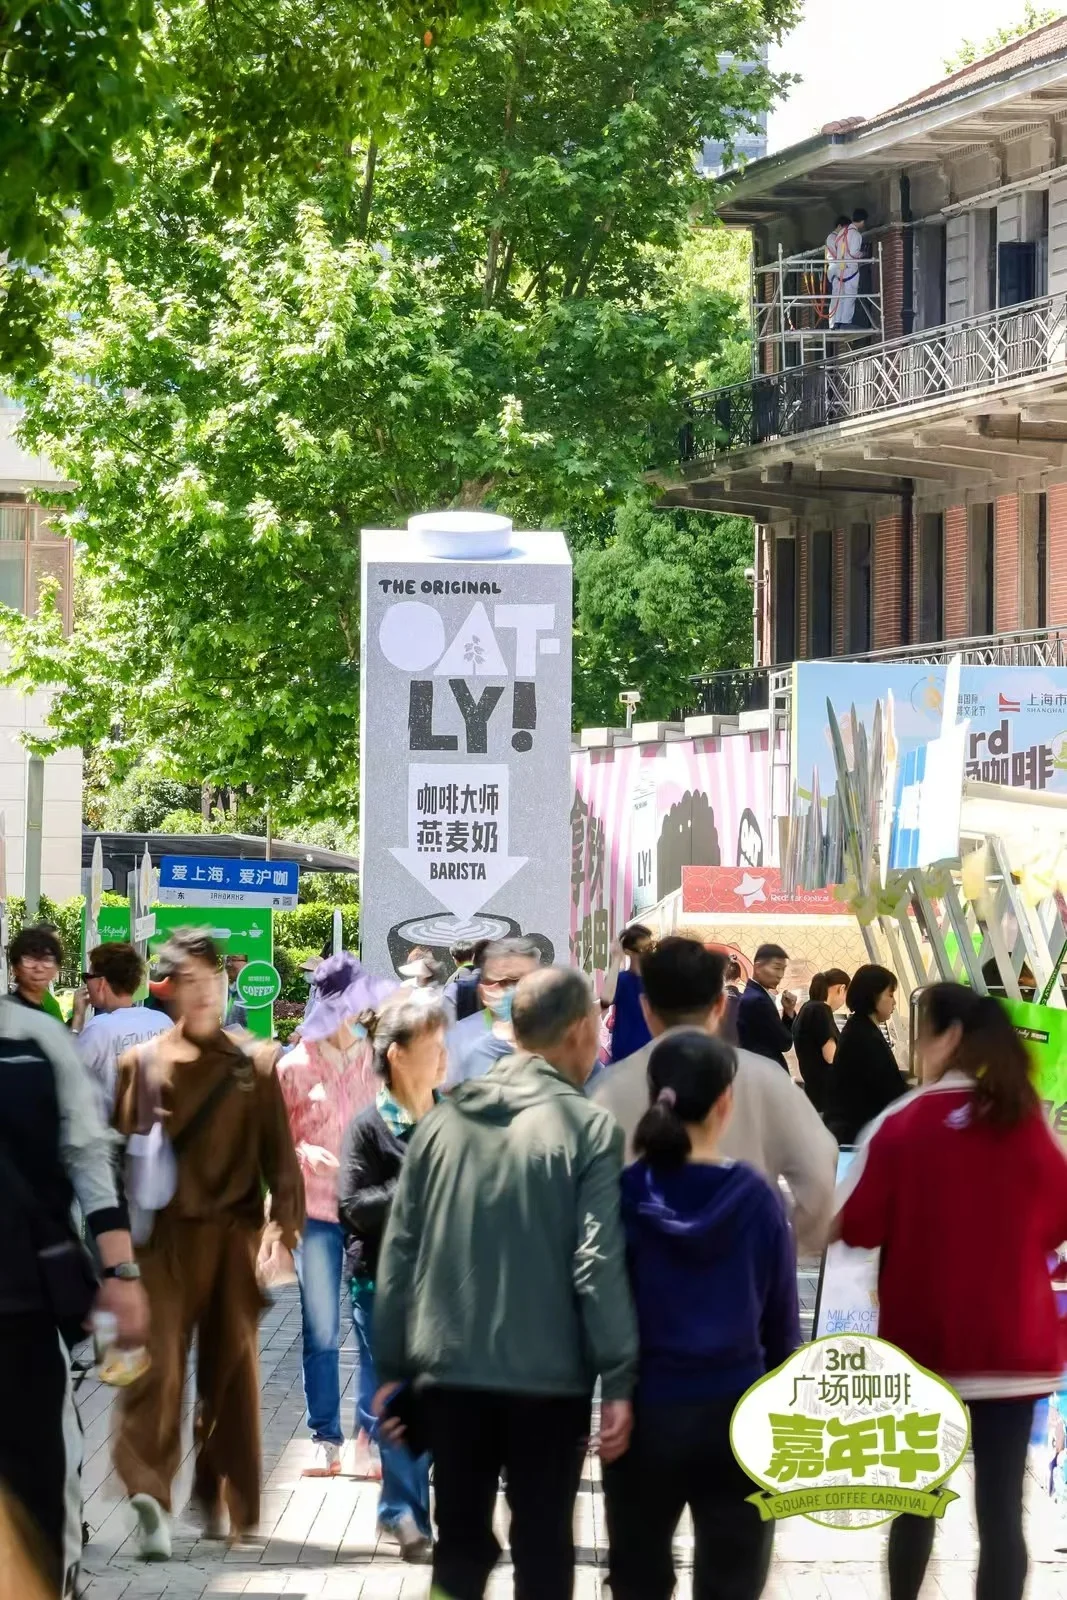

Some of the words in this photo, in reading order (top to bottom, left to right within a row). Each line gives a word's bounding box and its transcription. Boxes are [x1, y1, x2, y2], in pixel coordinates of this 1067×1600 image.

[378, 579, 416, 595] THE
[420, 580, 502, 595] ORIGINAL
[408, 678, 537, 753] LY!
[417, 783, 499, 816] 咖啡大师
[416, 820, 498, 853] 燕麦奶
[430, 862, 486, 880] BARISTA
[242, 985, 276, 997] COFFEE
[827, 1309, 856, 1321] MILK
[825, 1321, 870, 1333] CREAM
